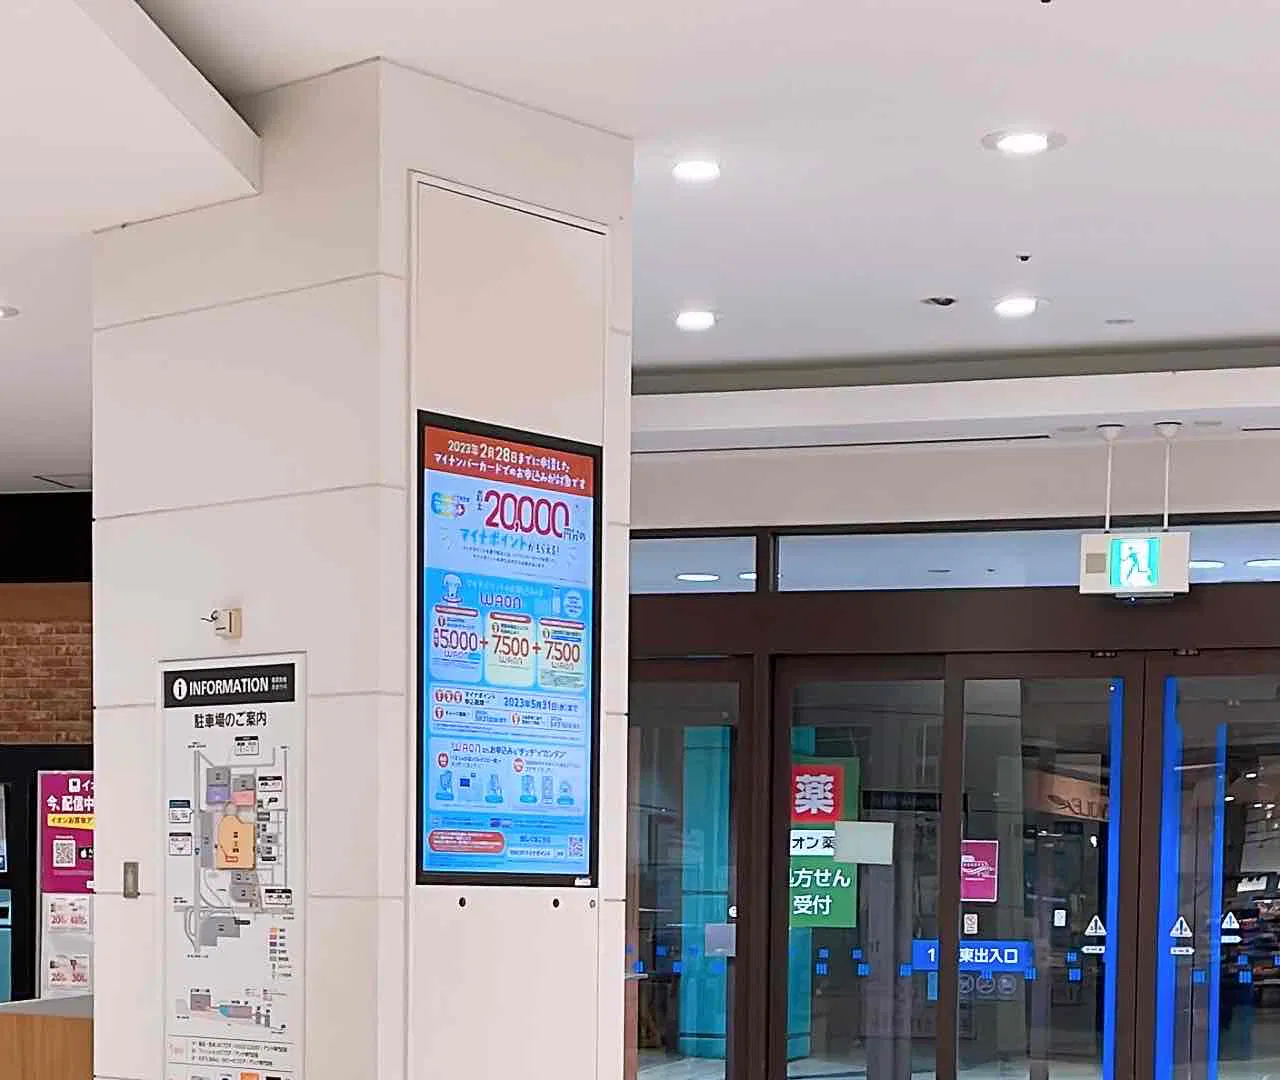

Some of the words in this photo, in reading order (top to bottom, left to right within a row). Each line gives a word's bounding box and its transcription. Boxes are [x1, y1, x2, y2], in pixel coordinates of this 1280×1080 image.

[484, 490, 570, 538] 20,000
[189, 677, 269, 696] INFORMATION
[194, 711, 267, 729] 駐車場のご案内
[794, 774, 834, 814] 薬
[790, 867, 851, 888] 方せん
[793, 895, 832, 916] 受付
[960, 947, 1019, 964] 東出入口
